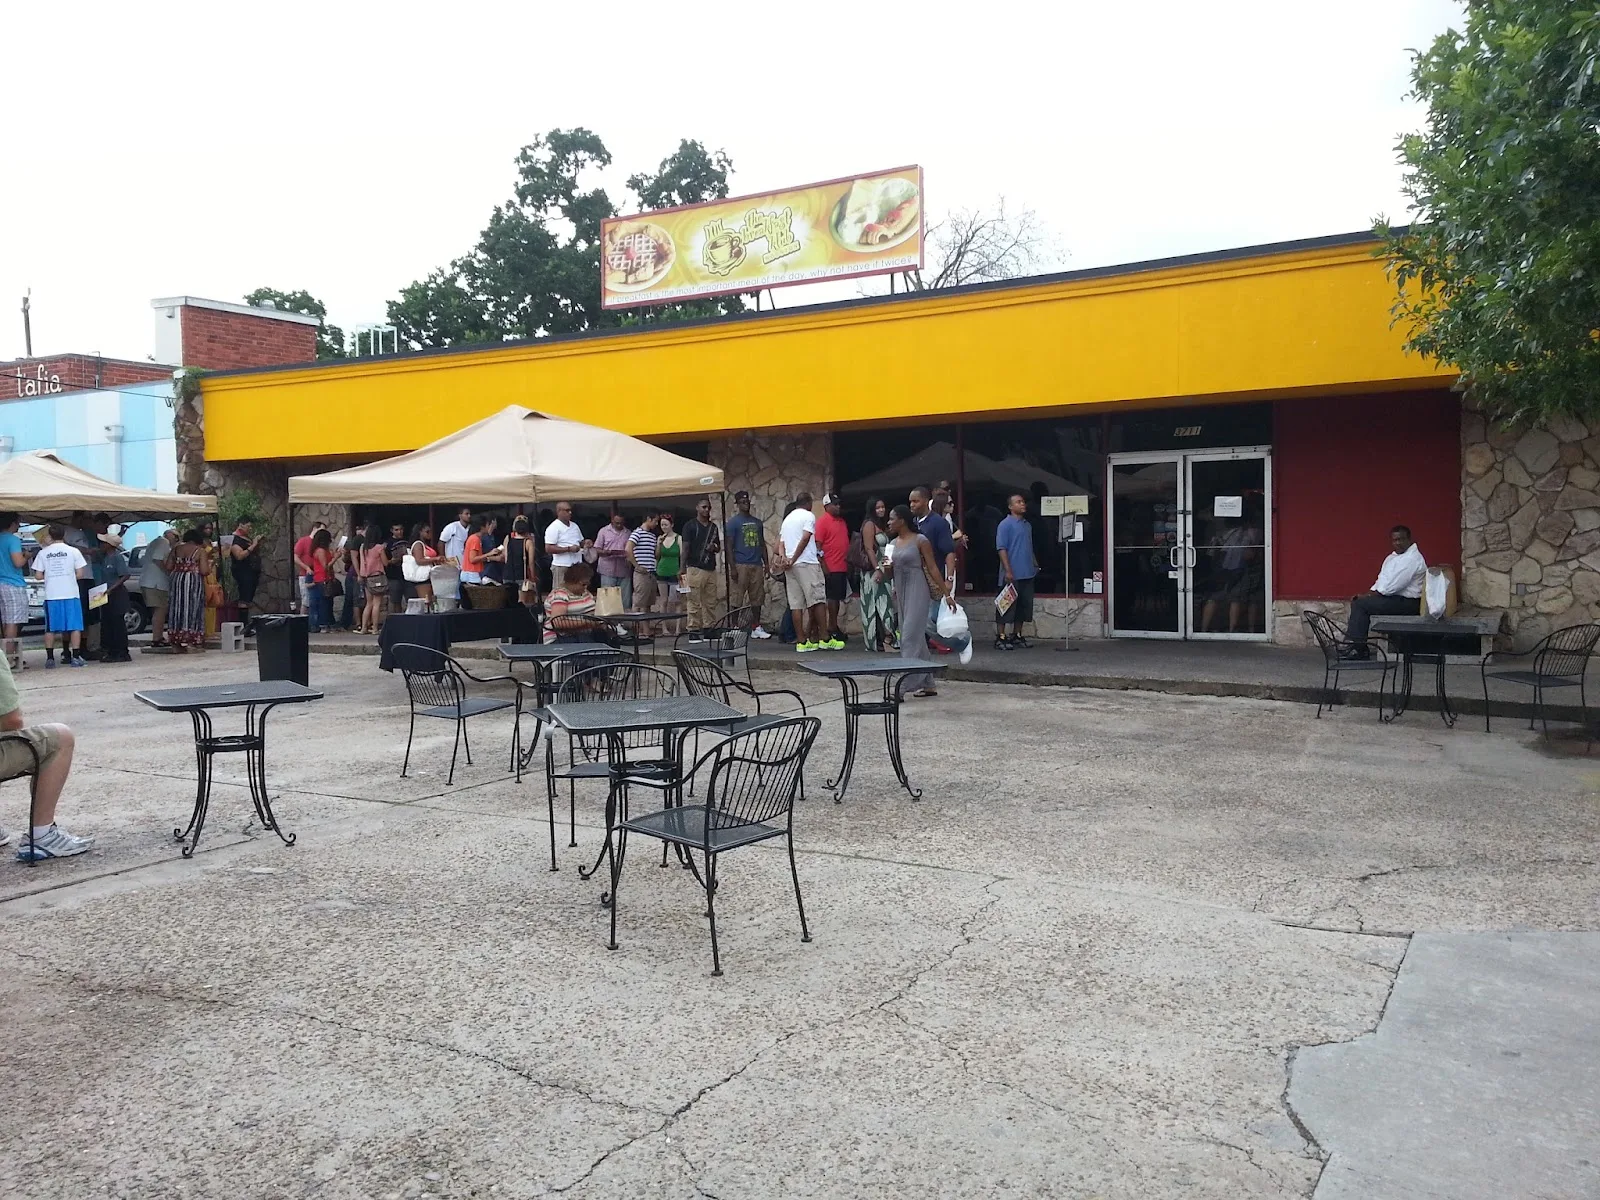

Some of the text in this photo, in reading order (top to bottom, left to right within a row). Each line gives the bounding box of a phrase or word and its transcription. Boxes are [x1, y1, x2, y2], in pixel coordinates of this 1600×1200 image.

[617, 292, 652, 302] breakfast
[676, 286, 695, 295] most
[696, 281, 735, 293] important
[736, 278, 758, 286] meal
[761, 276, 769, 284] of
[772, 274, 785, 282] the
[810, 268, 826, 277] why
[830, 265, 844, 274] not
[848, 262, 869, 271] have
[881, 256, 912, 267] twice?
